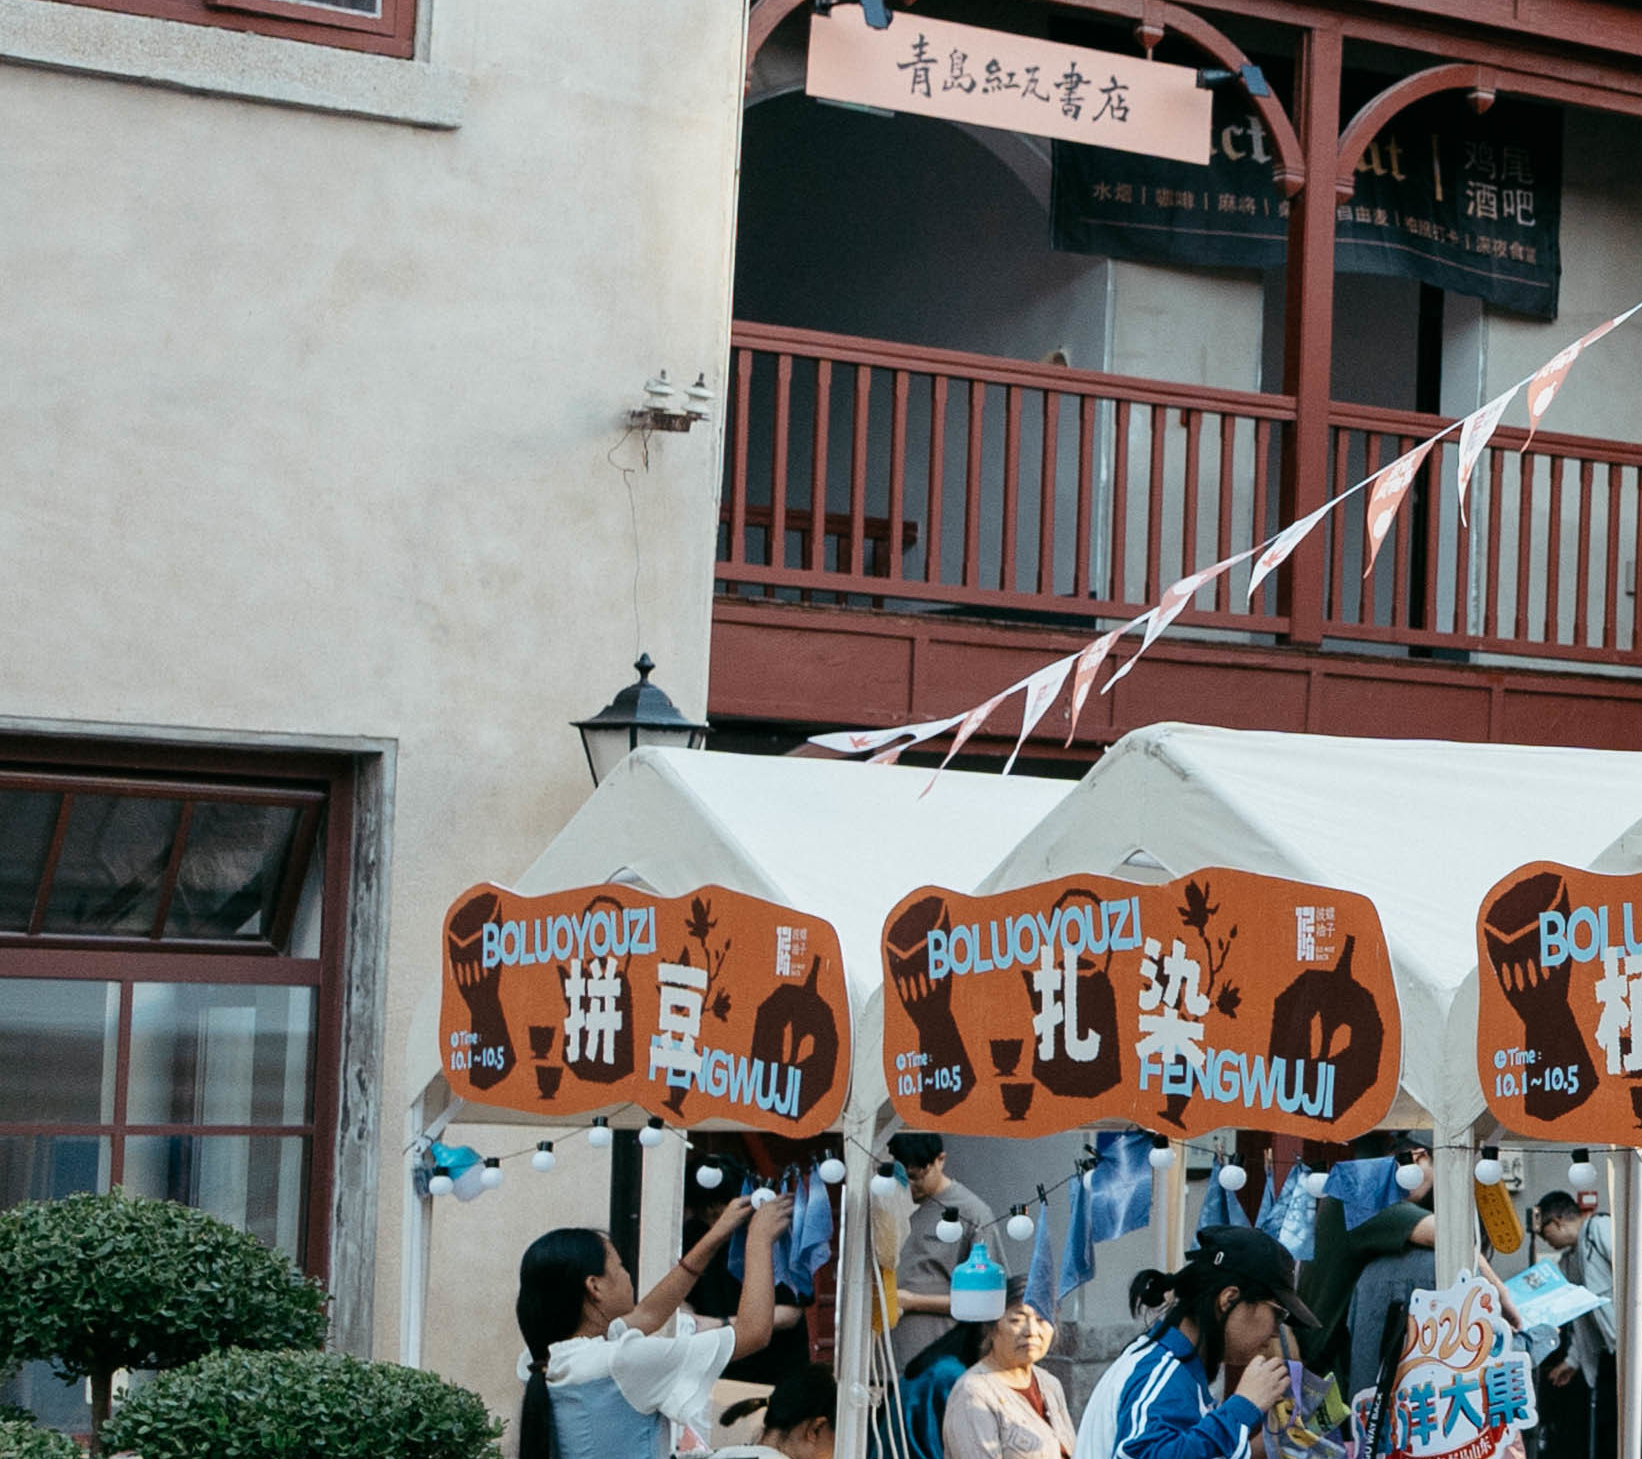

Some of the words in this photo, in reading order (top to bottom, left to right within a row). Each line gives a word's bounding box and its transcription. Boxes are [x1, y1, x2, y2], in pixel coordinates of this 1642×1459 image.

[1466, 181, 1536, 226] 酒吧
[482, 906, 657, 969] BOLUOYOUZI
[928, 897, 1142, 979] BOLUOYOUZI
[564, 957, 708, 1073] 拼豆
[1032, 936, 1210, 1064] 扎染
[450, 1046, 505, 1071] 10.1~10.5
[897, 1070, 962, 1097] 10.1~10.5
[1495, 1067, 1579, 1097] 10.1~10.5
